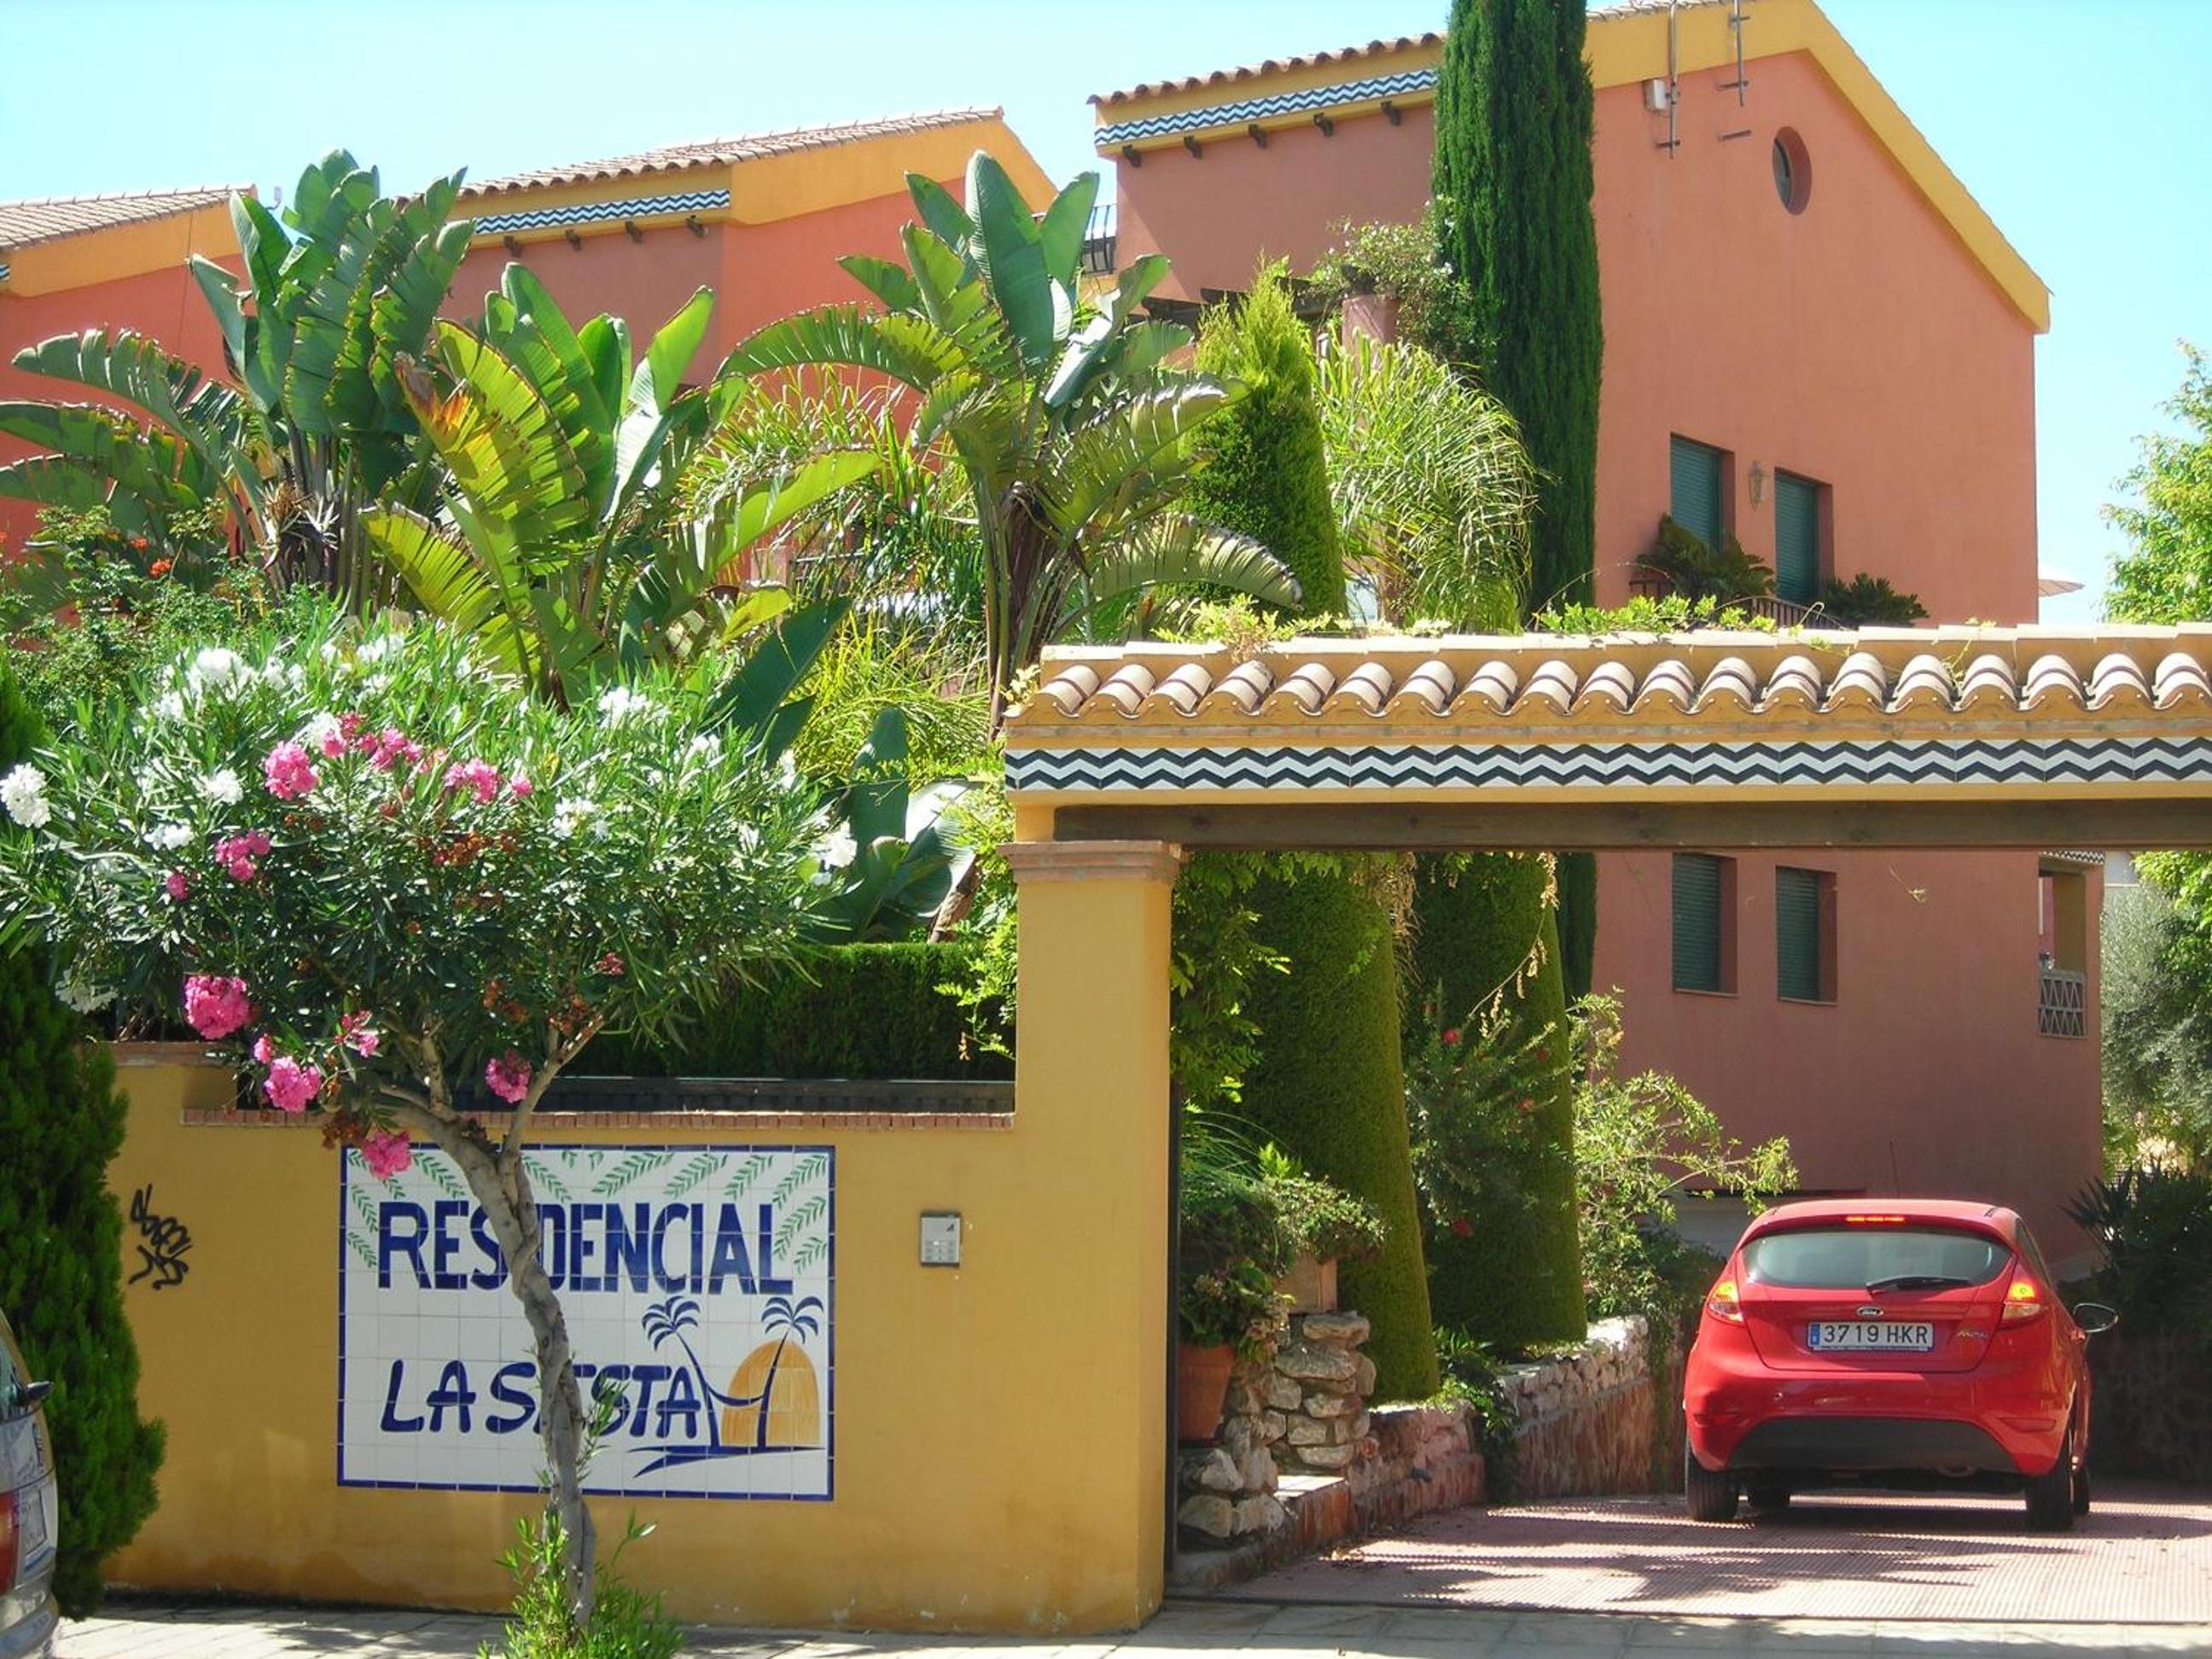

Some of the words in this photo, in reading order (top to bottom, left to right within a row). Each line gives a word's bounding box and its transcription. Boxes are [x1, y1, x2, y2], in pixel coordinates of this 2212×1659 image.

[377, 1199, 794, 1295] RESDENCIAL
[1823, 1324, 1879, 1344] 3719
[1887, 1325, 1930, 1344] HKR
[380, 1359, 477, 1434] LA
[485, 1361, 702, 1440] SSTA
